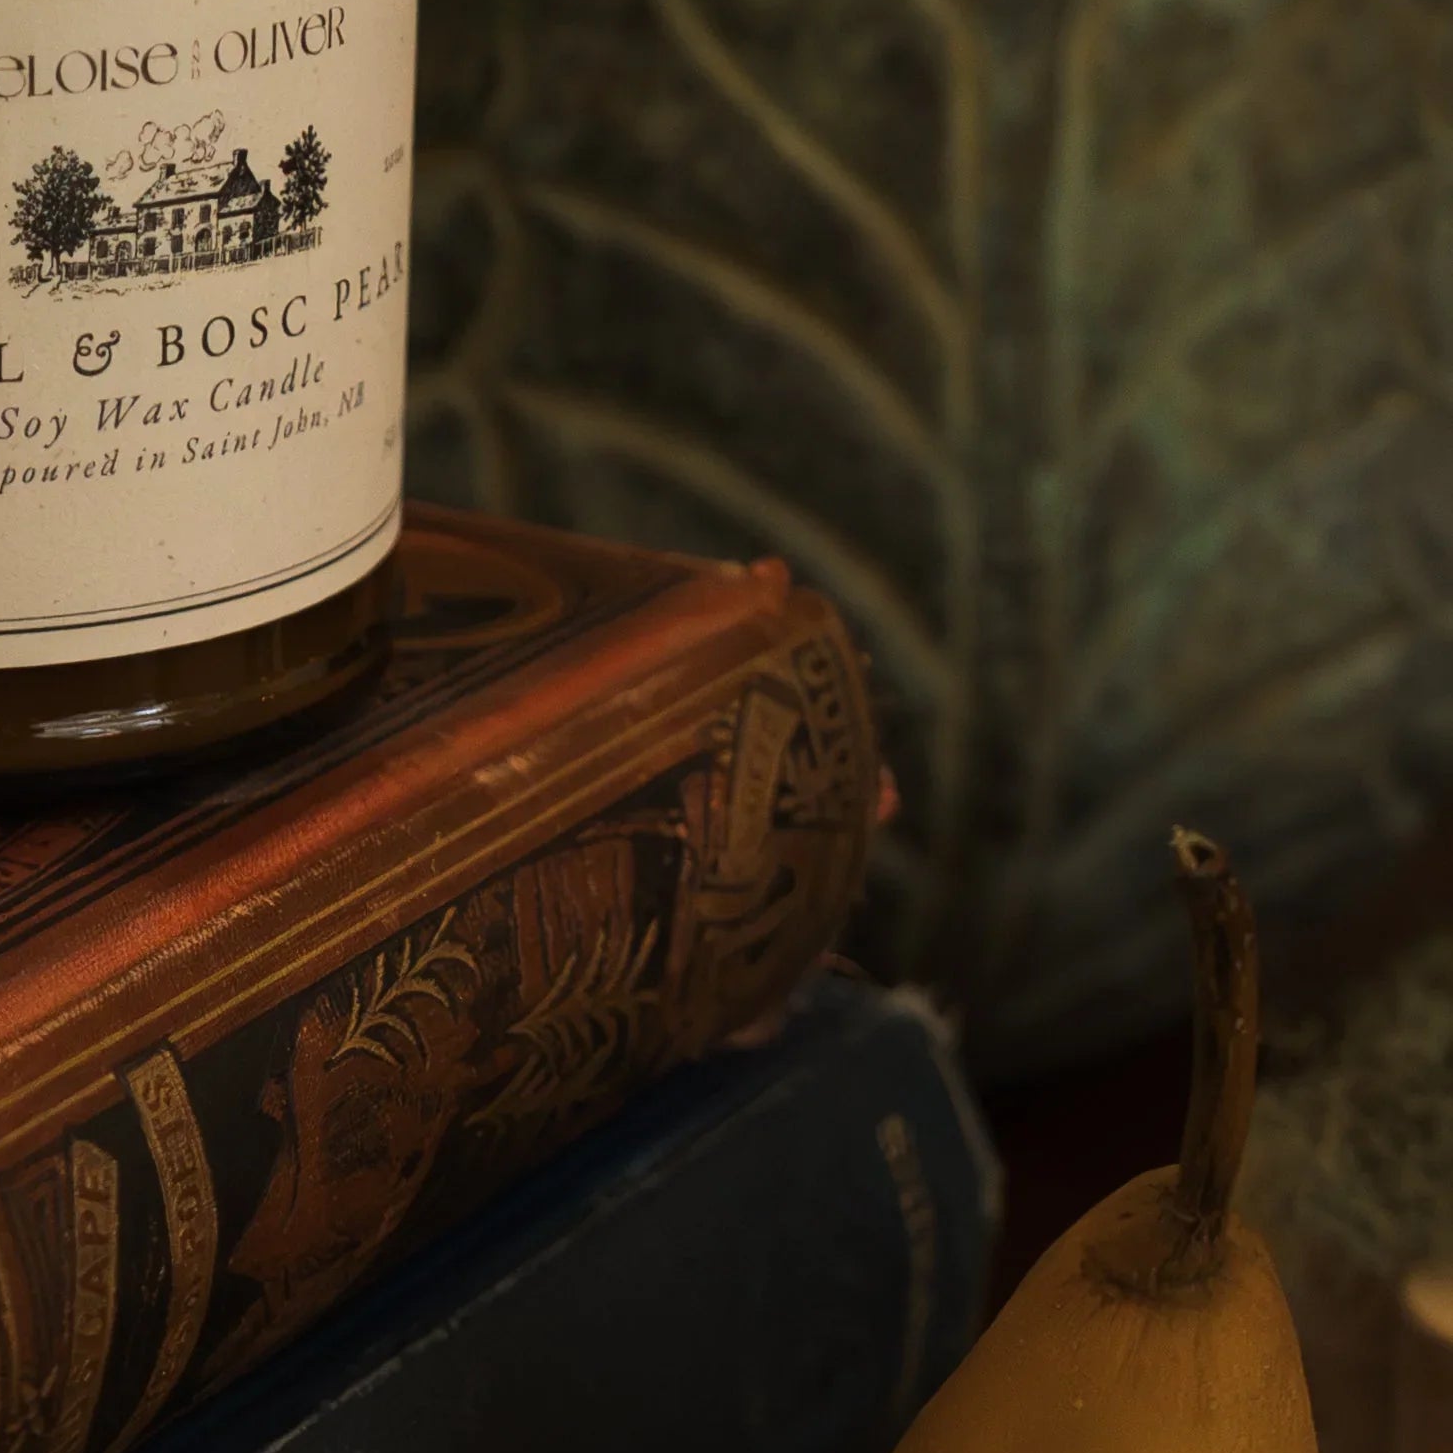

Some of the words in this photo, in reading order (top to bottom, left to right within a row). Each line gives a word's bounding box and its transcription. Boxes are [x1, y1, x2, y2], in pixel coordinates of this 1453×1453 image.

[72, 330, 121, 376] &
[156, 295, 308, 367] BOSC
[96, 395, 190, 431] Wax
[209, 352, 325, 412] Candle
[135, 447, 166, 474] in
[181, 428, 262, 465] Saint
[266, 406, 329, 451] John,
